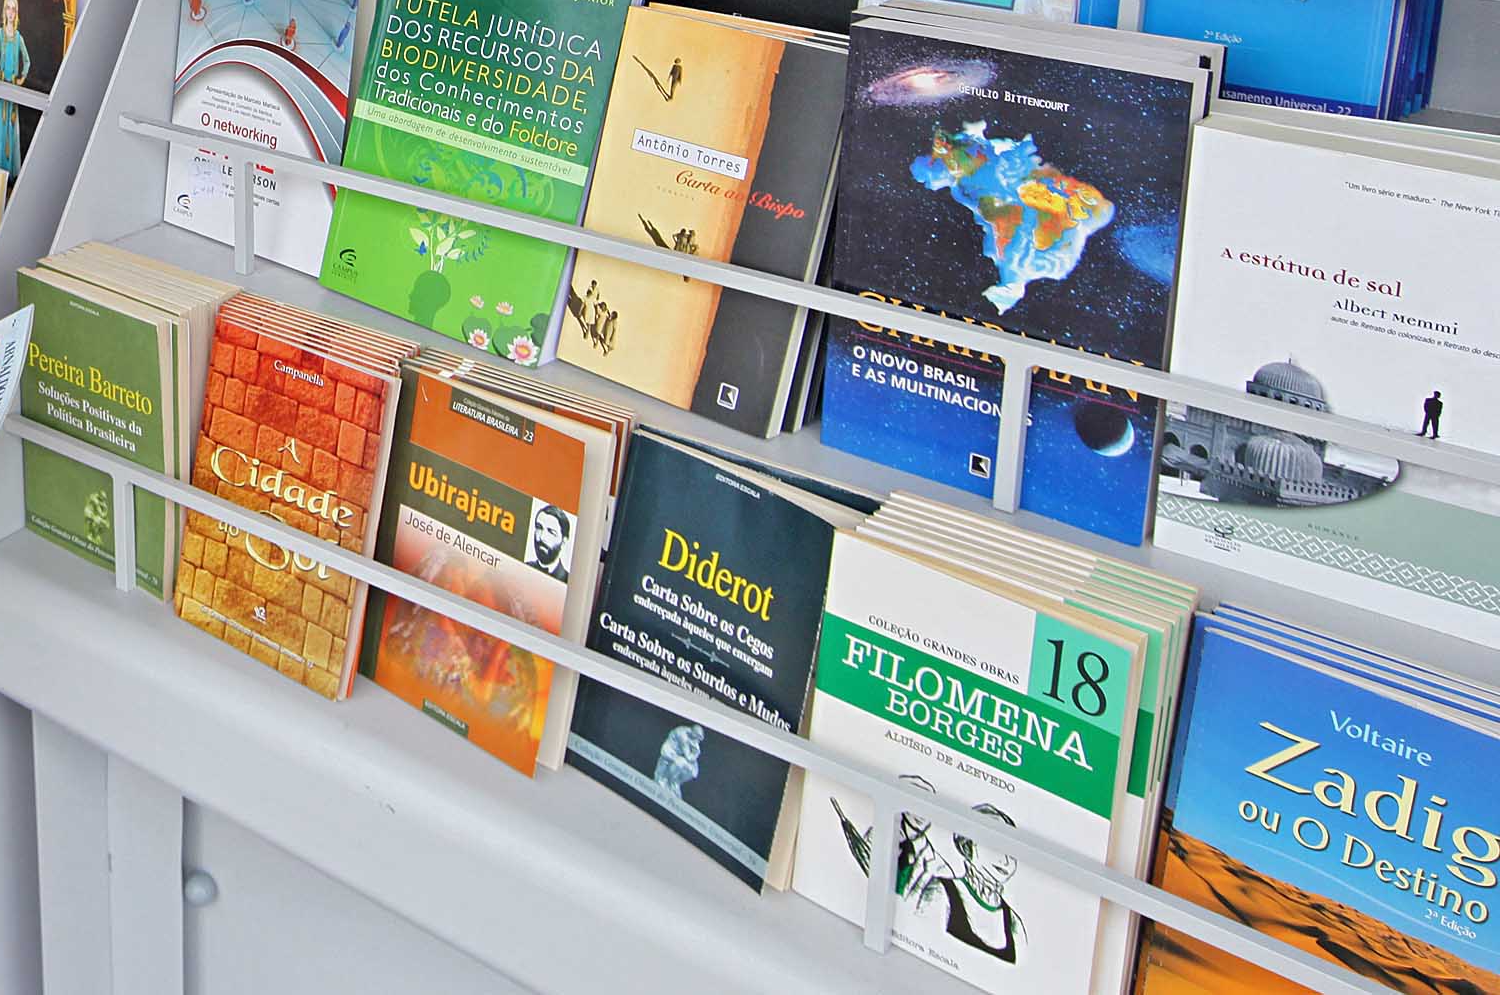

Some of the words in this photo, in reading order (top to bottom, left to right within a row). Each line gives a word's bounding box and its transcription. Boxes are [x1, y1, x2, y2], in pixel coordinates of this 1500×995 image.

[387, 15, 431, 44] DOS
[438, 28, 553, 76] RECURSOS
[562, 58, 595, 87] DA
[485, 14, 601, 60] JURÍDICA
[376, 63, 410, 91] dos
[420, 73, 584, 134] Conhecimentos
[381, 38, 587, 115] BIODIVERSIDADE,
[958, 82, 999, 101] GETULIO
[1004, 90, 1069, 113] BITTENCOURT
[201, 113, 210, 127] O
[215, 120, 278, 149] networking
[373, 80, 460, 123] Tradicionais
[466, 113, 476, 126] e
[482, 115, 503, 136] do
[509, 122, 577, 158] Folclore
[638, 134, 689, 160] Antônio
[697, 150, 740, 174] Torres
[676, 170, 720, 197] Carta
[749, 191, 805, 220] Bispo
[1221, 247, 1233, 259] A
[1239, 249, 1326, 282] estátua
[1333, 267, 1360, 288] de
[1367, 275, 1402, 298] sal
[1333, 298, 1387, 321] Albert
[28, 342, 84, 388] Pereira
[89, 365, 152, 415] Barreto
[274, 360, 324, 387] Campanella
[853, 345, 866, 361] O
[870, 349, 917, 376] NOVO
[923, 364, 979, 392] BRASIL
[38, 381, 80, 409] Soluções
[83, 398, 126, 428] Positivas
[129, 420, 142, 436] da
[47, 401, 82, 429] Política
[86, 420, 136, 452] Brasileira
[452, 401, 485, 425] LITERATURA
[487, 414, 519, 438] BRASILEIRA
[524, 429, 534, 442] 23
[278, 439, 300, 463] A
[211, 445, 354, 528] Cidade
[408, 462, 516, 535] Ubirajara
[405, 511, 433, 536] José
[436, 526, 450, 543] de
[453, 535, 500, 567] Alencar
[658, 529, 774, 622] Diderot
[642, 575, 678, 606] Carta
[681, 592, 718, 624] Sobre
[721, 619, 734, 635] os
[737, 625, 773, 660] Cegos
[869, 615, 919, 642] COLEÇÃO
[923, 637, 977, 667] GRANDES
[981, 661, 1019, 685] OBRAS
[600, 612, 637, 646] Carta
[639, 629, 675, 664] Sobre
[678, 656, 689, 670] os
[692, 660, 737, 703] Surdos
[739, 693, 746, 703] e
[748, 692, 791, 732] Mudos
[842, 633, 1093, 772] FILOMENA
[1043, 638, 1109, 717] 18
[885, 689, 1023, 766] BORGES
[1329, 710, 1433, 767] Voltaire
[885, 729, 932, 756] ALUÍSIO
[936, 753, 953, 765] DE
[957, 760, 1015, 794] AZEVEDO
[1245, 722, 1500, 887] Zadig
[1238, 800, 1280, 833] ou
[1293, 817, 1329, 850] O
[1341, 833, 1489, 924] Destino
